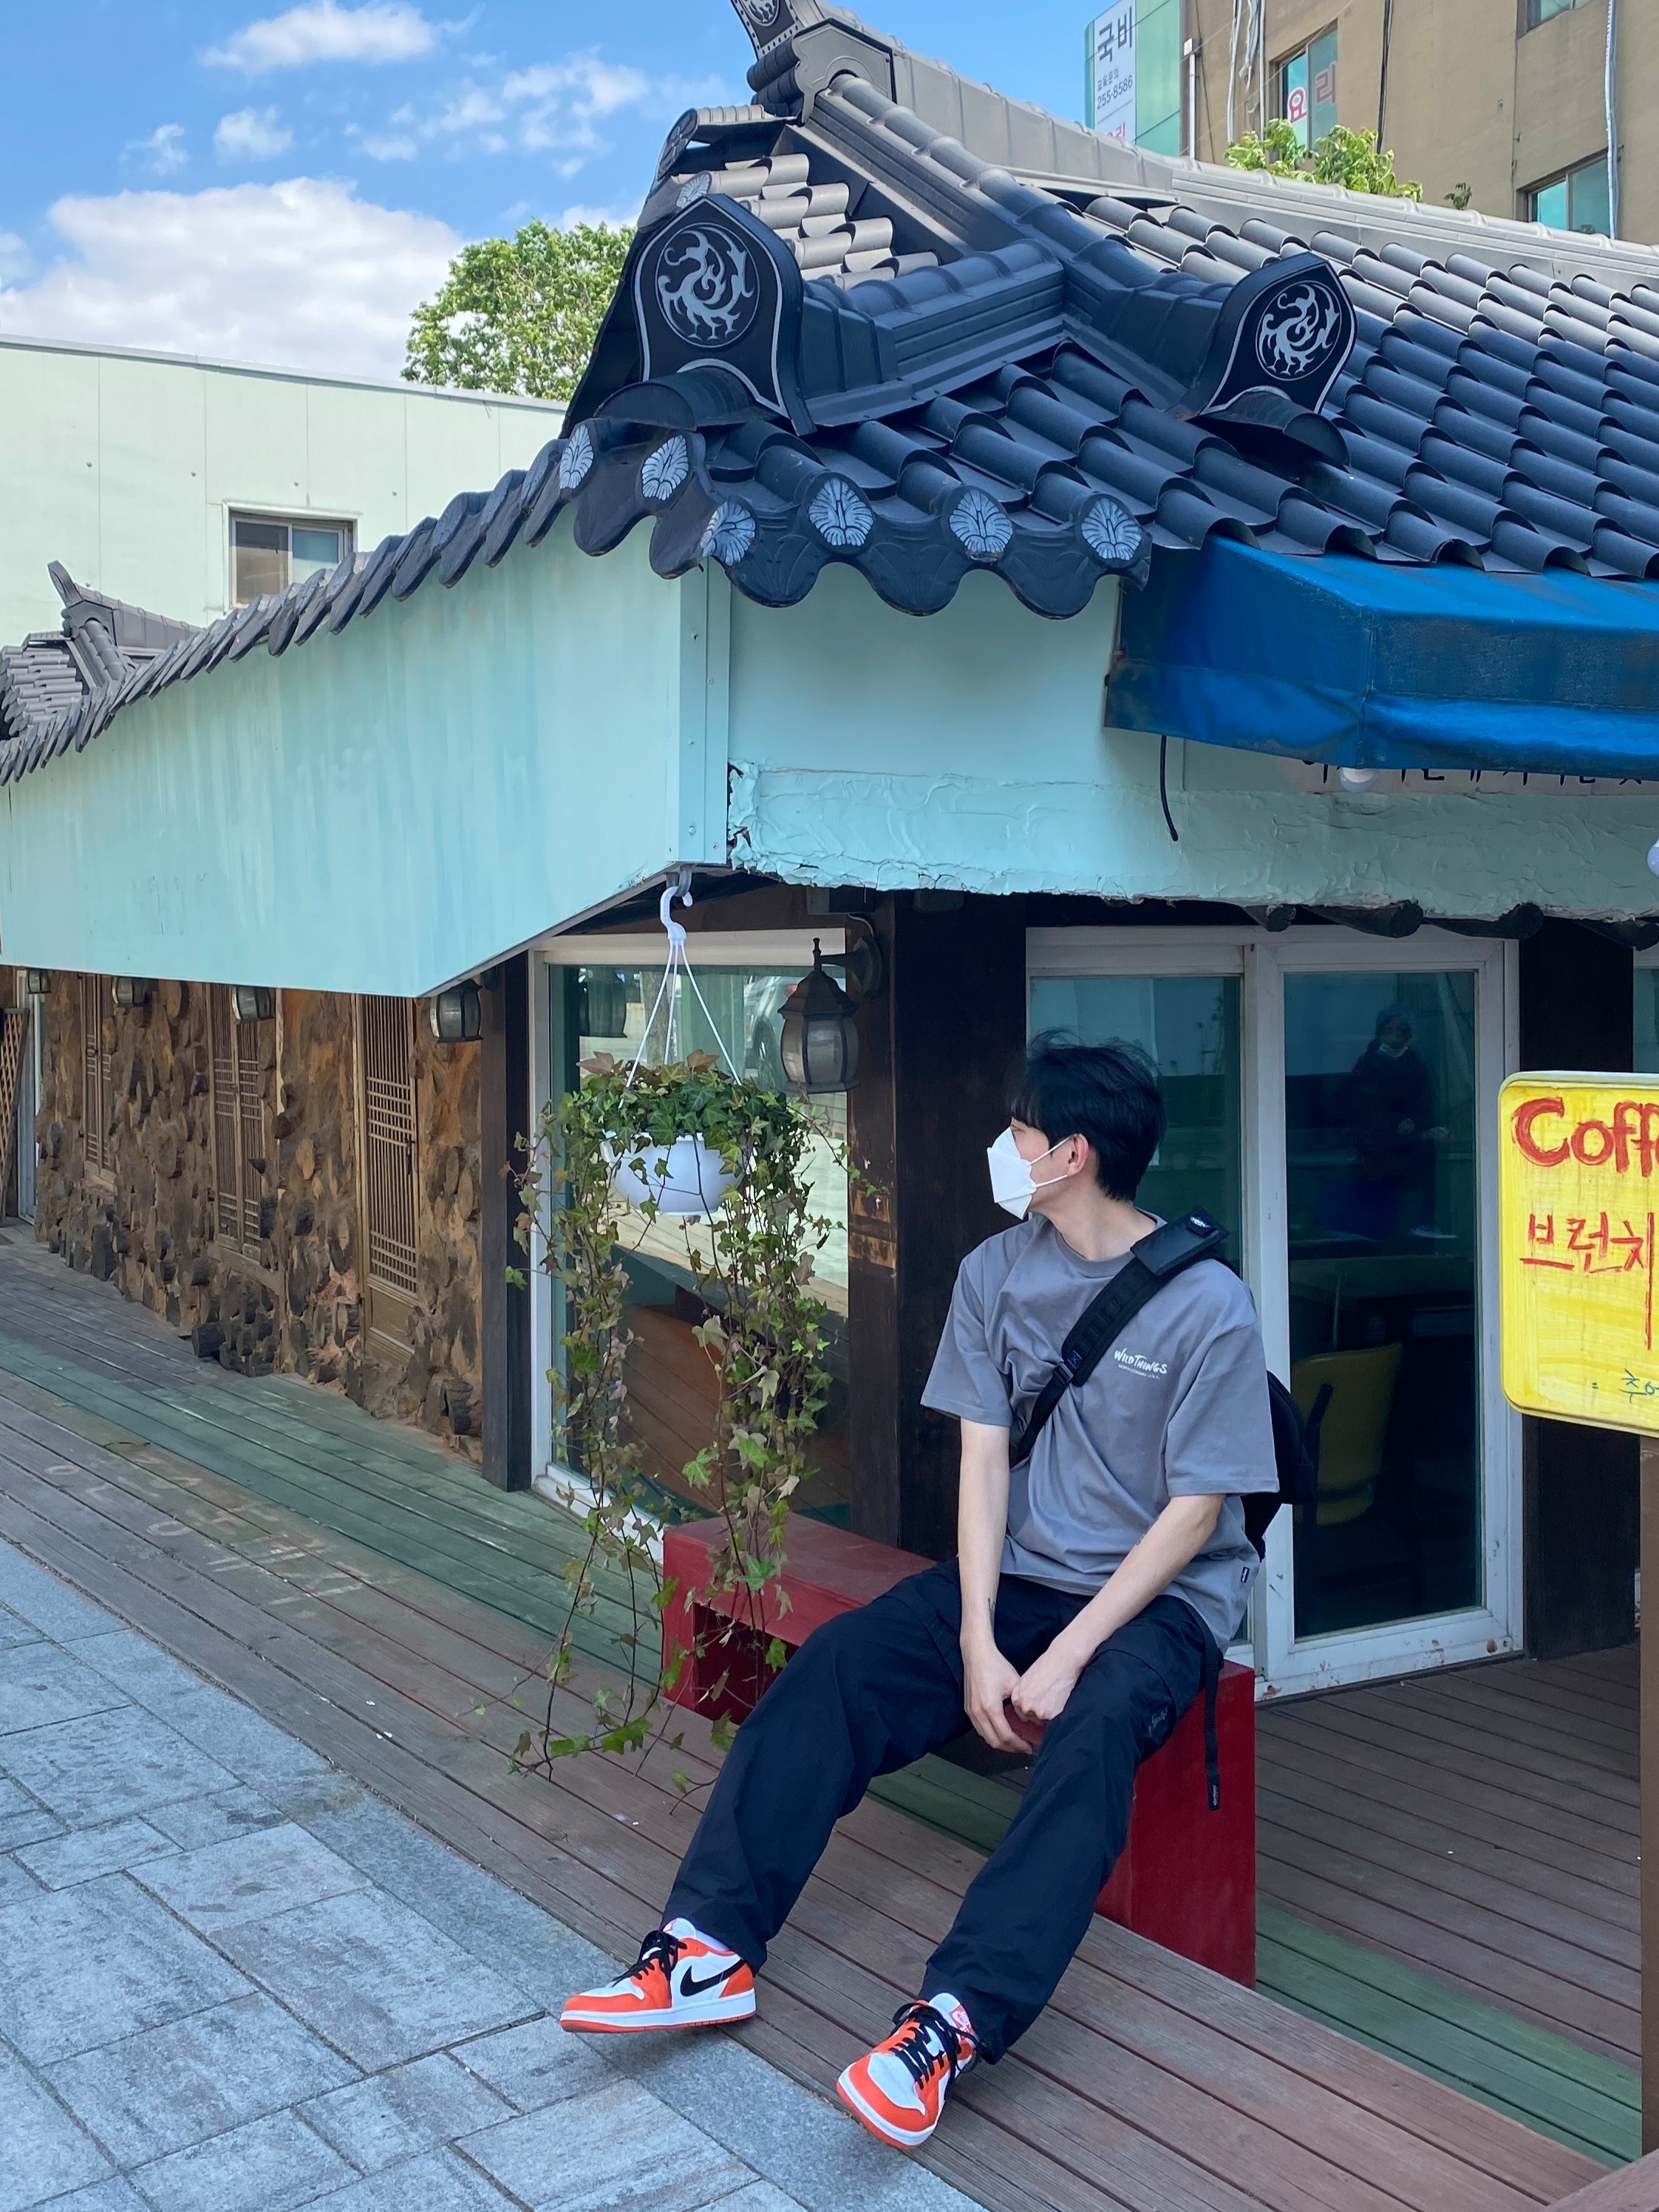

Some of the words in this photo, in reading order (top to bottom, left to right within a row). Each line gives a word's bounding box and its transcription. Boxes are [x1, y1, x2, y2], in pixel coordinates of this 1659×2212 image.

[1097, 5, 1133, 62] 국비
[1097, 67, 1119, 92] 교육문의
[1097, 75, 1133, 111] 255-8586
[1515, 1097, 1659, 1178] Coff
[1519, 1212, 1655, 1351] 브런치
